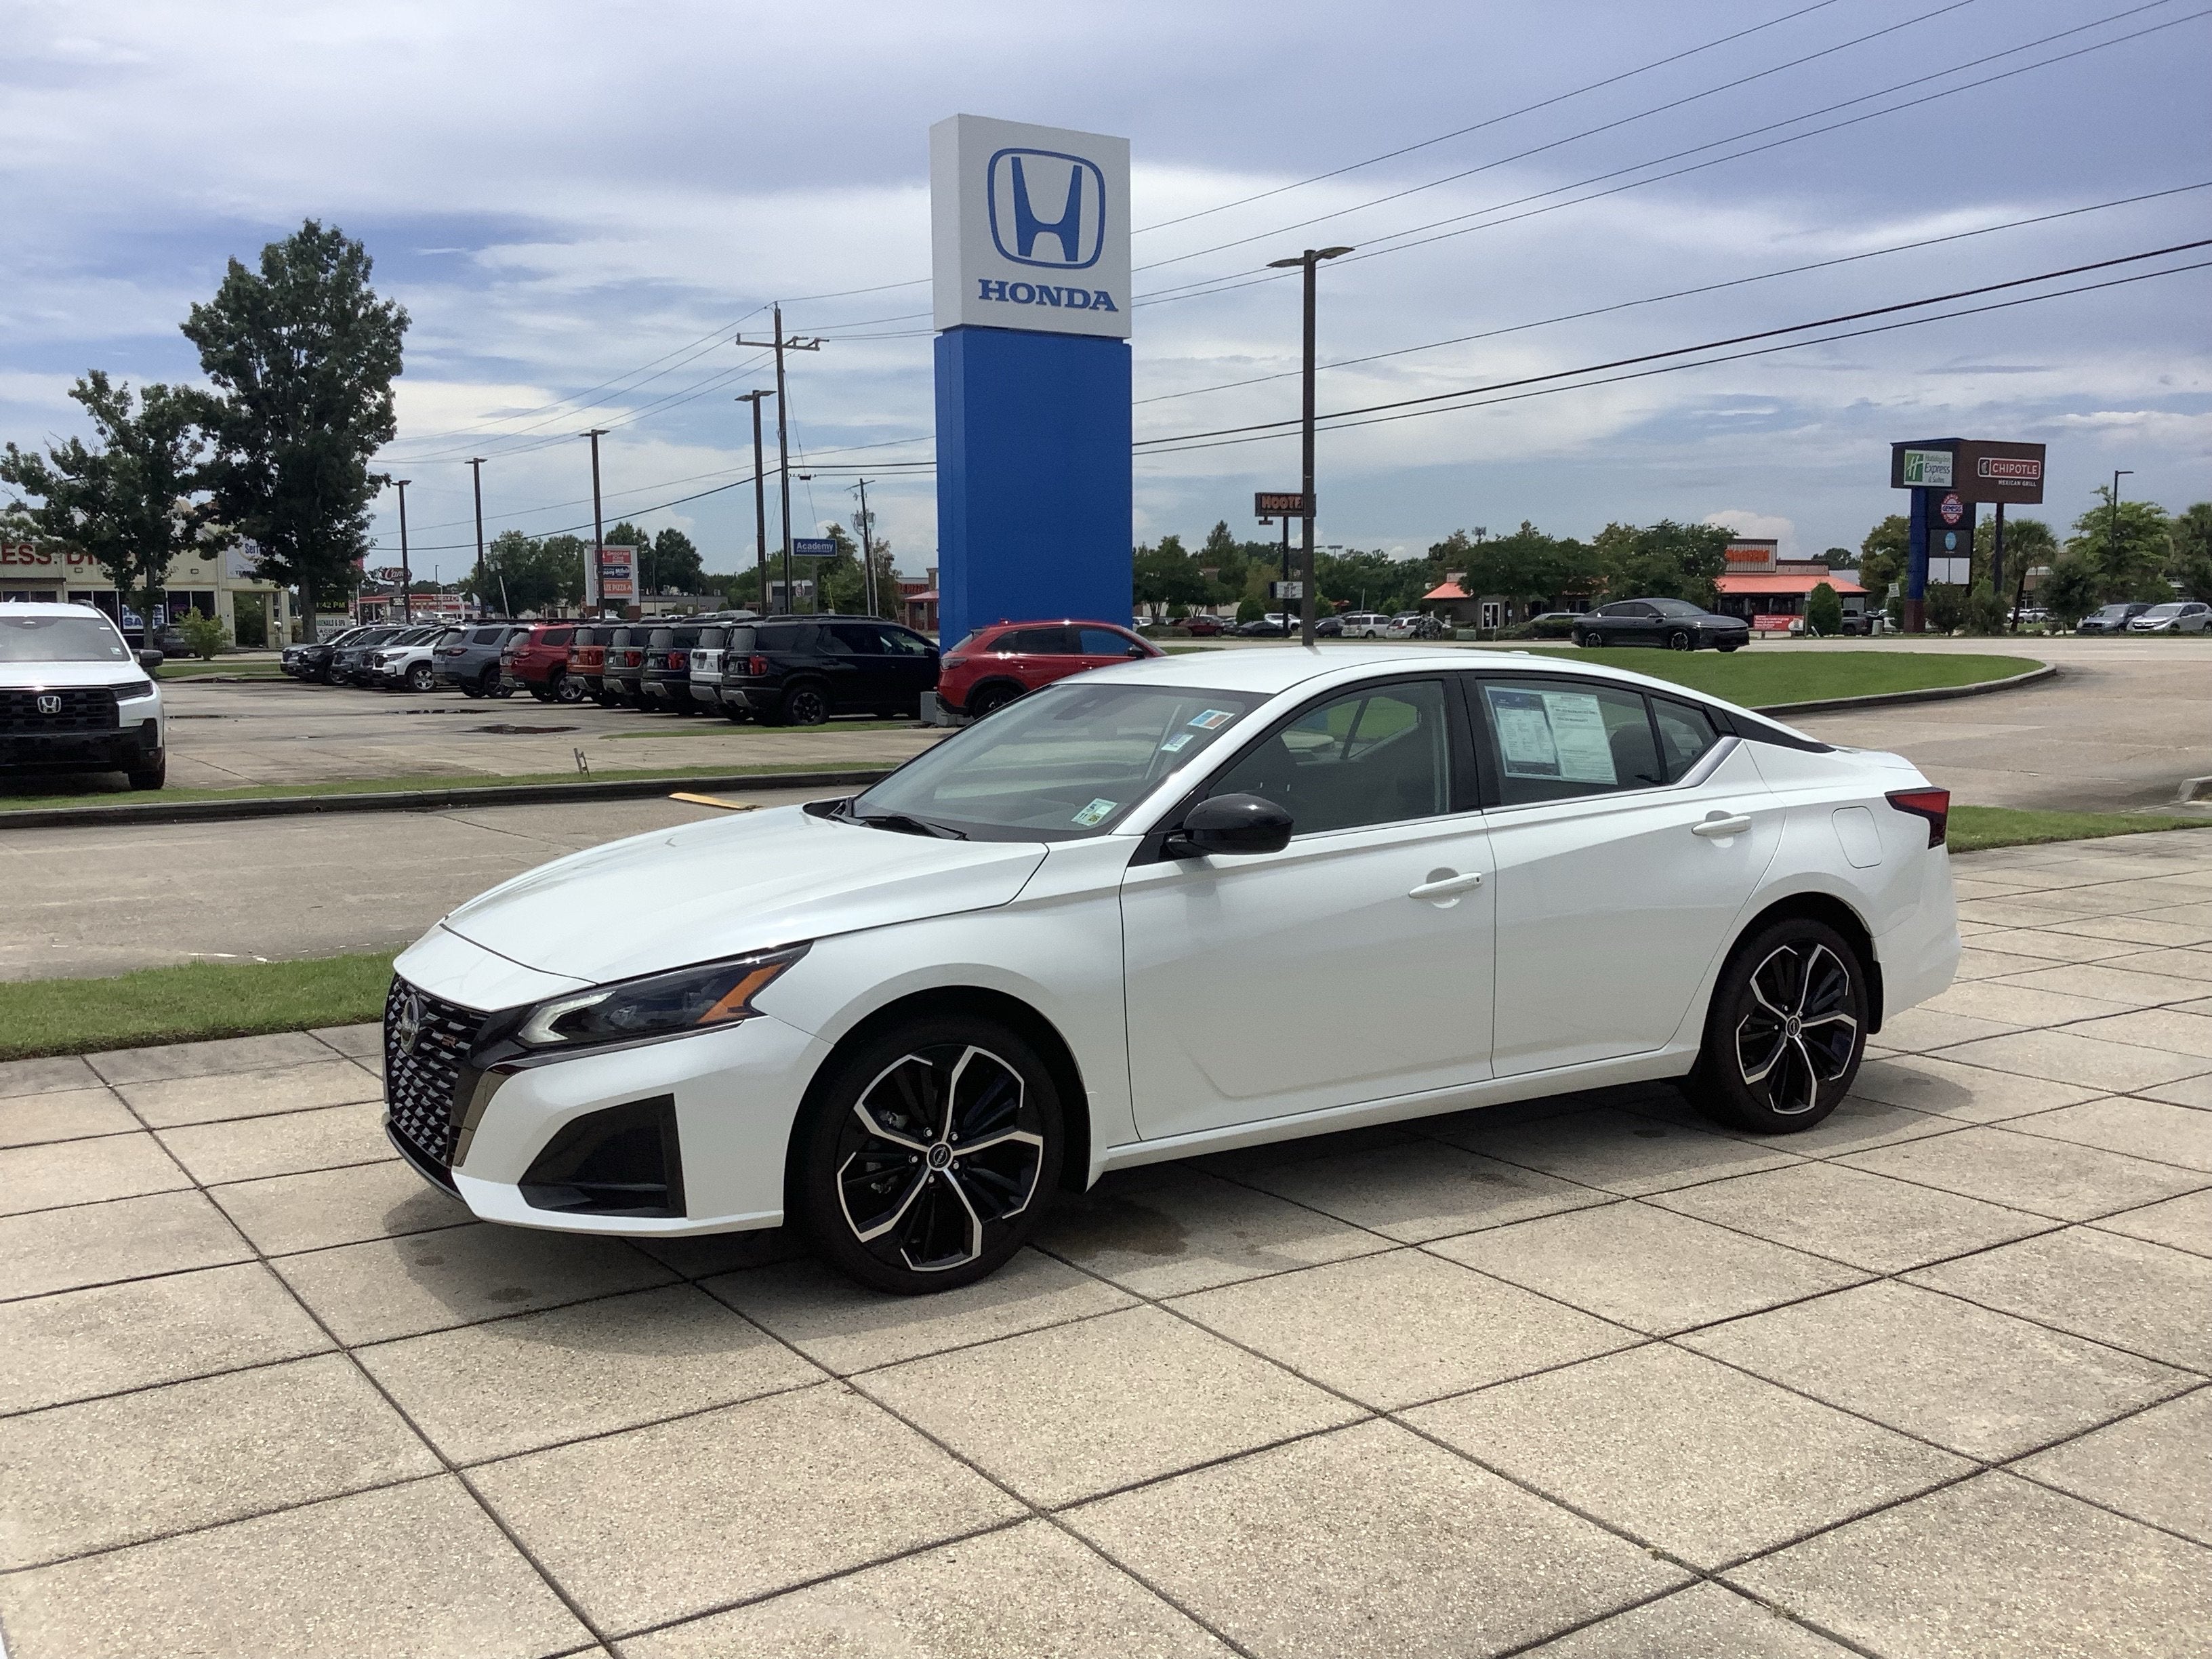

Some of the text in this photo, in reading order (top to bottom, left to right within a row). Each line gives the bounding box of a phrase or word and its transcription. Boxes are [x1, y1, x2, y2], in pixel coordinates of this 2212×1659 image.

[979, 279, 1119, 312] HONDA
[1925, 462, 1950, 476] Express
[1992, 463, 2037, 474] CHIPOTLE
[1261, 495, 1303, 510] HOOTE
[796, 542, 834, 552] Academy
[124, 617, 162, 626] SAE
